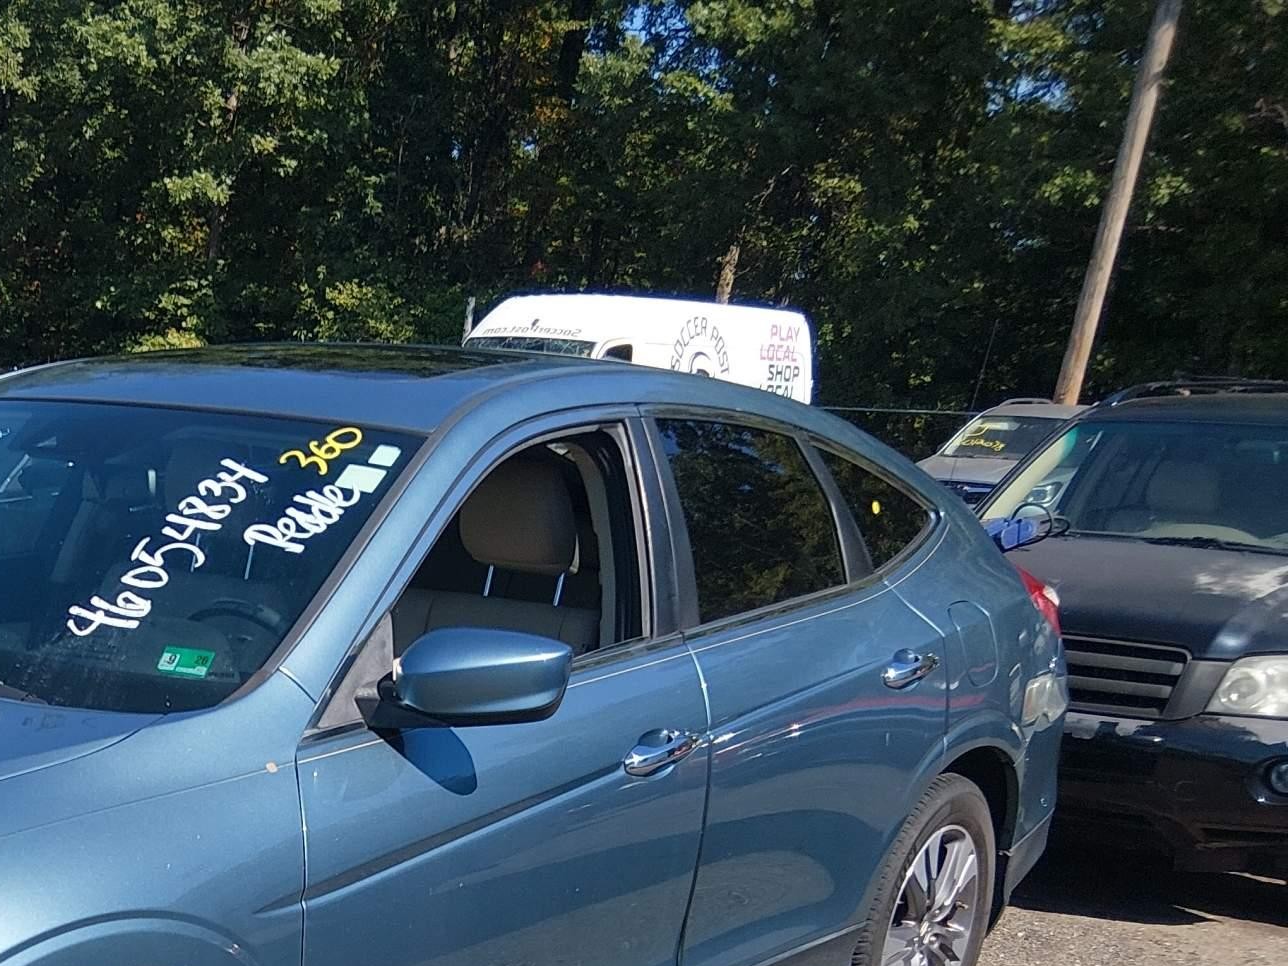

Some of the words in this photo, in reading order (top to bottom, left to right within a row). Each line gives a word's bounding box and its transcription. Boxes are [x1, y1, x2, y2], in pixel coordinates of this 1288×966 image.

[671, 316, 708, 371] SOCCER
[710, 326, 730, 374] POST
[770, 324, 800, 341] PLAY
[759, 344, 798, 362] LOCAL
[767, 364, 800, 382] SHOP
[279, 427, 362, 475] 360
[67, 458, 268, 636] 46054834
